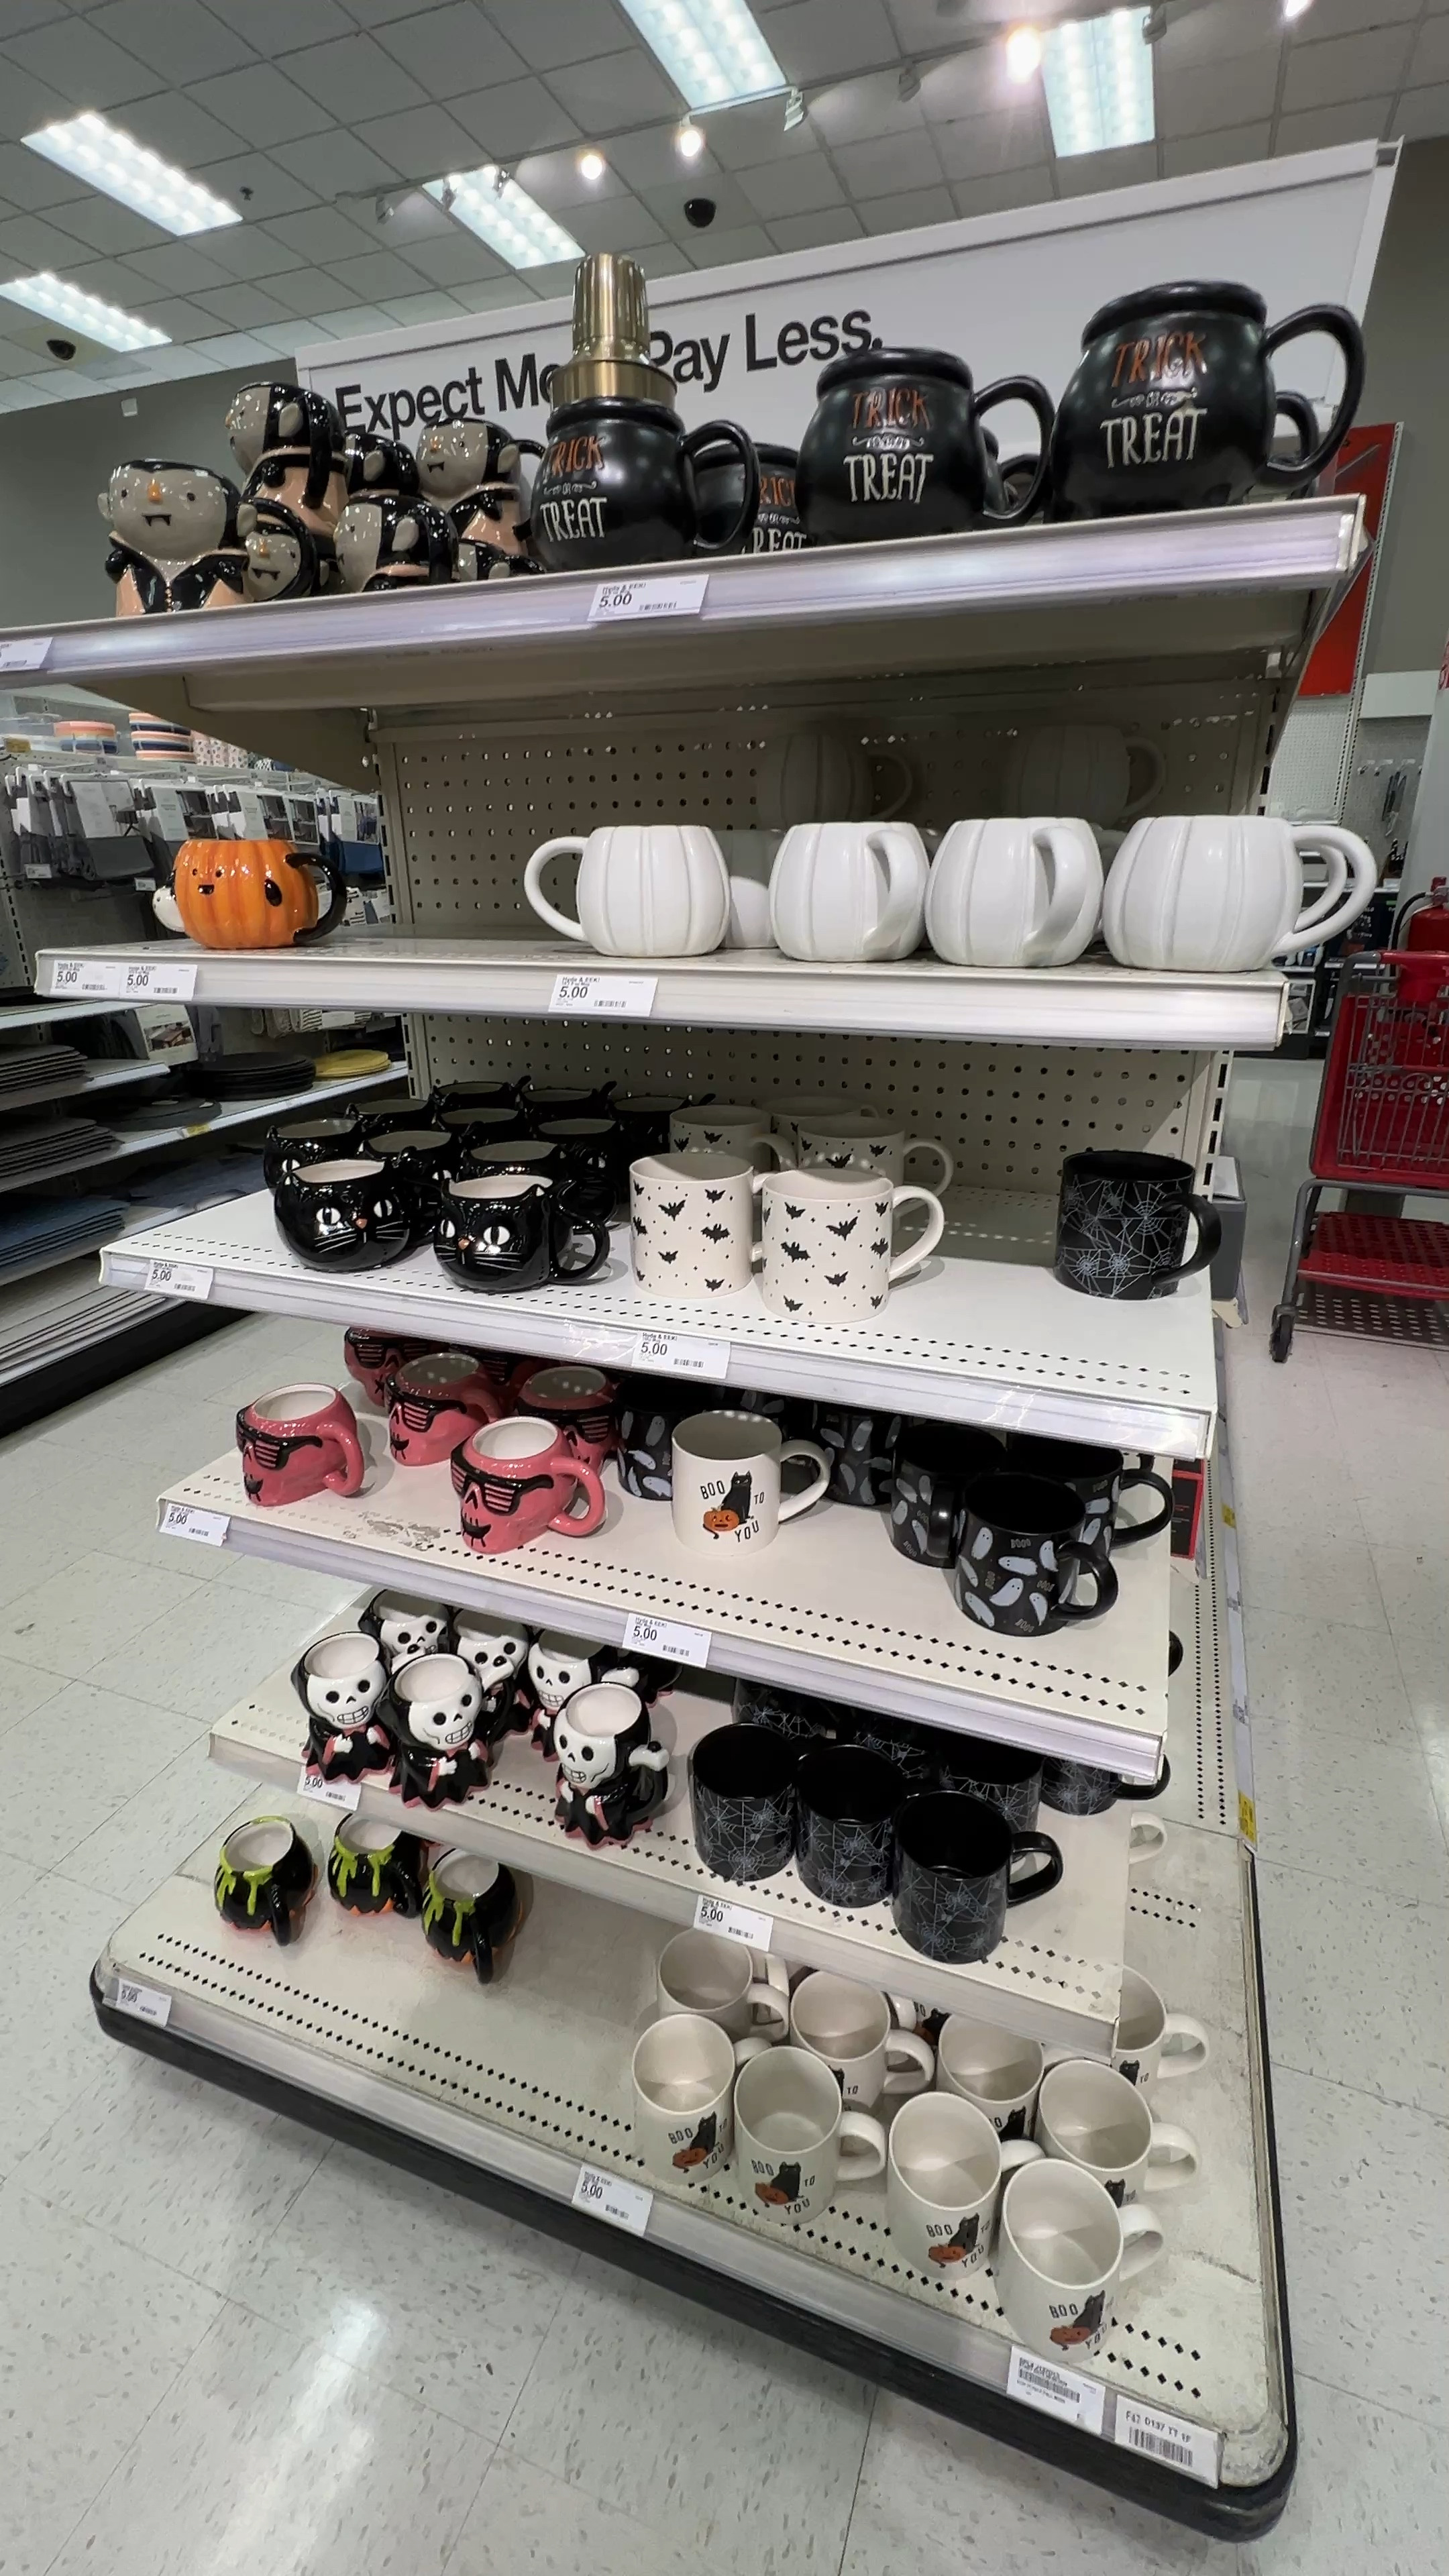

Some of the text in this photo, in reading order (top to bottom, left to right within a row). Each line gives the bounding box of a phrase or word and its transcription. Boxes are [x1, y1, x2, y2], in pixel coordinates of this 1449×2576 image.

[1111, 331, 1208, 388] TRICK
[335, 367, 484, 439] Expect
[649, 330, 731, 393] Pay
[853, 386, 931, 430] TRICK
[1099, 408, 1208, 468] TREAT
[542, 435, 605, 484] TRICK
[843, 453, 934, 504] TREAT
[760, 477, 795, 507] RIC
[540, 496, 608, 542] TREAT
[598, 593, 633, 608] 5.00
[56, 971, 78, 983] 5.00
[127, 975, 149, 986] 5.00
[559, 986, 588, 999] 5.00
[152, 1269, 172, 1281] 5.00
[641, 1342, 667, 1356] 5.00
[700, 1480, 725, 1500] BOO
[753, 1491, 765, 1505] TO
[168, 1512, 187, 1525] 5.00
[734, 1519, 759, 1543] YOU
[633, 1625, 657, 1641] 5.00
[700, 1906, 724, 1923] 5.00
[846, 2085, 859, 2095] TO
[667, 2127, 694, 2145] BOO
[702, 2143, 724, 2169] YOU
[751, 2159, 774, 2176] BOO
[804, 2175, 816, 2187] TO
[581, 2180, 603, 2200] 5.00
[784, 2198, 810, 2215] YOU
[926, 2224, 953, 2238] BOO
[961, 2244, 984, 2268] YOU
[1049, 2302, 1079, 2319] BOO
